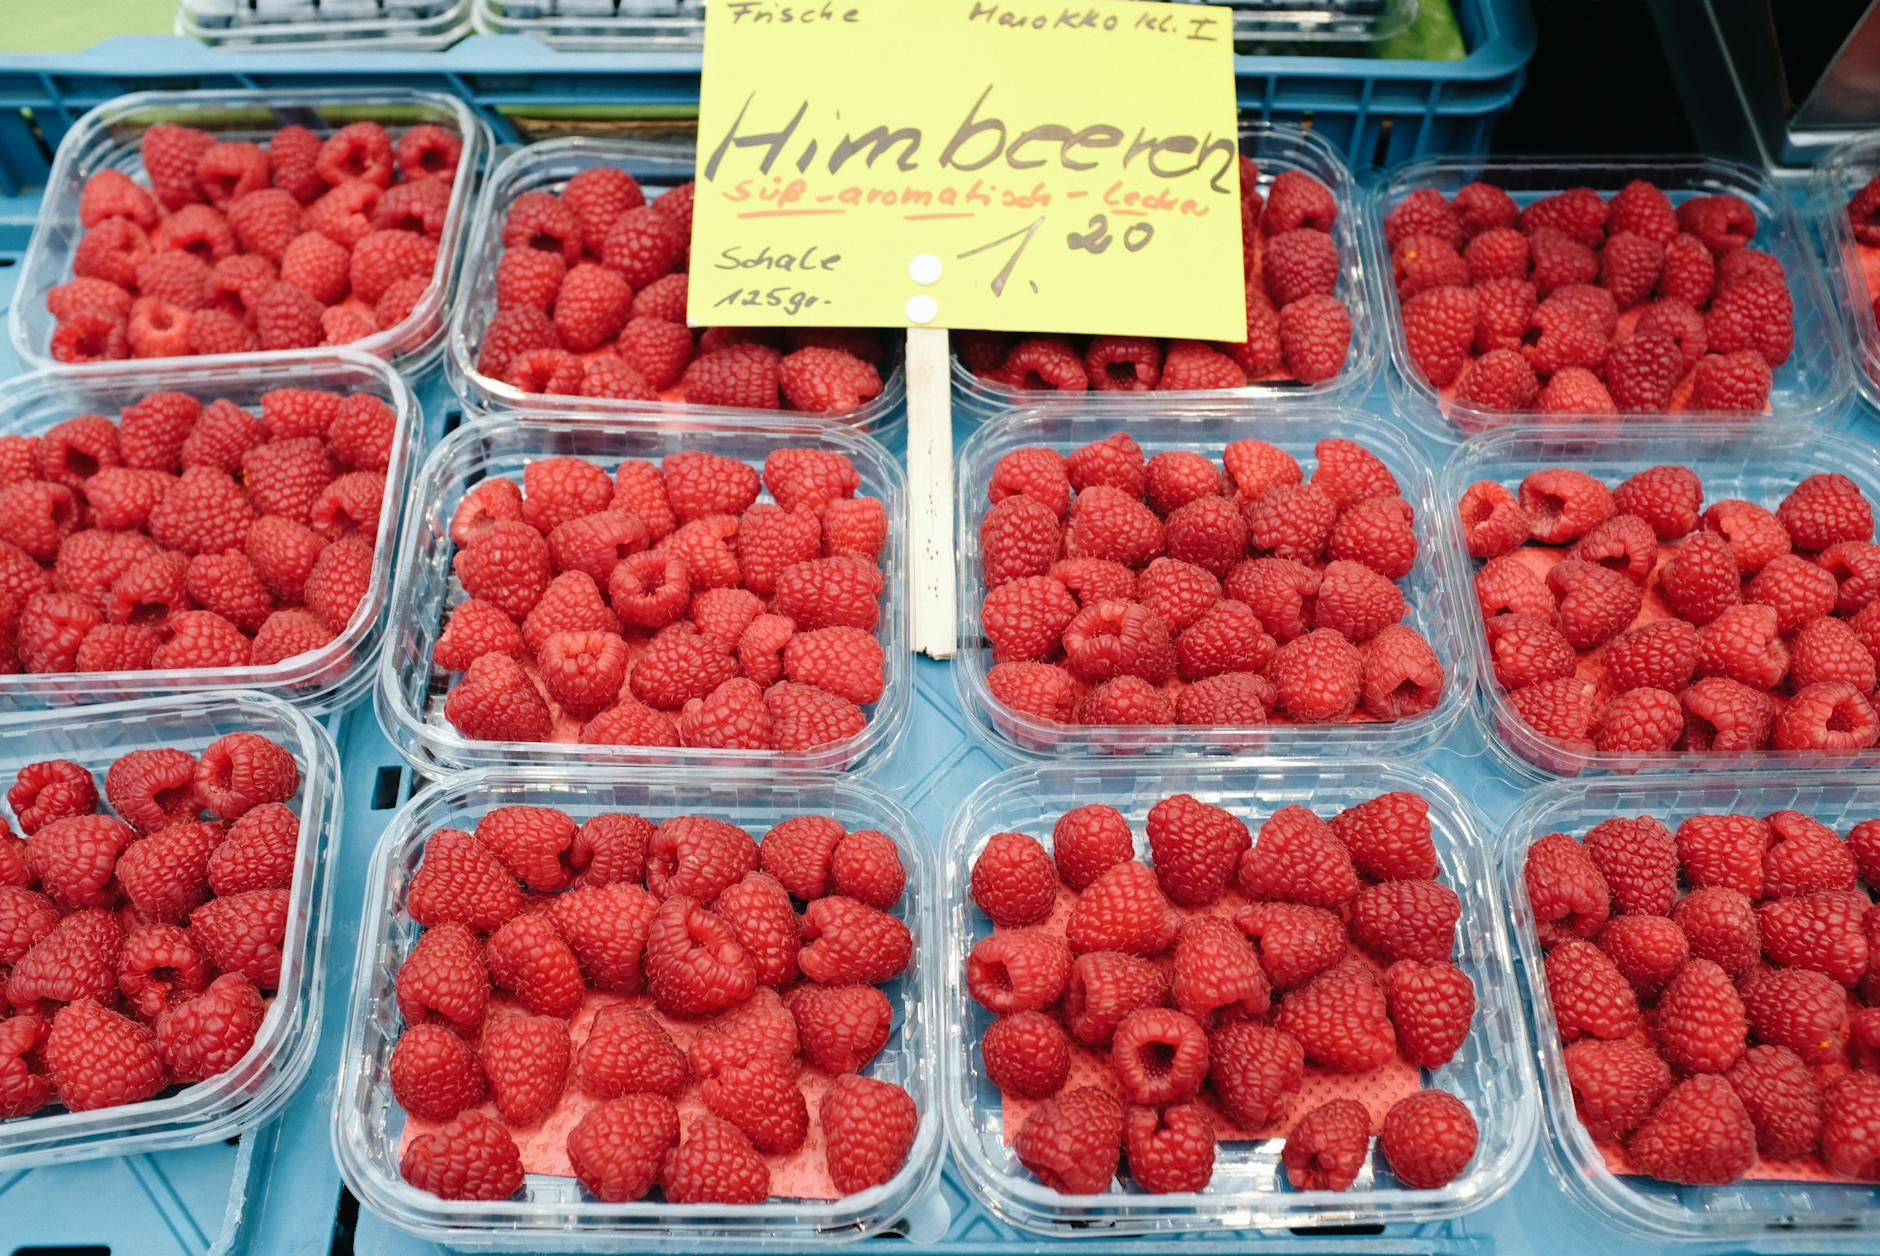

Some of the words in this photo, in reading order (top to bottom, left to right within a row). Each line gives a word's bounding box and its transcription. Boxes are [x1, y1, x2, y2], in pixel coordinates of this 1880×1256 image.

[727, 1, 861, 25] Frische
[703, 84, 1238, 194] Himbeeren
[713, 246, 842, 272] Schale
